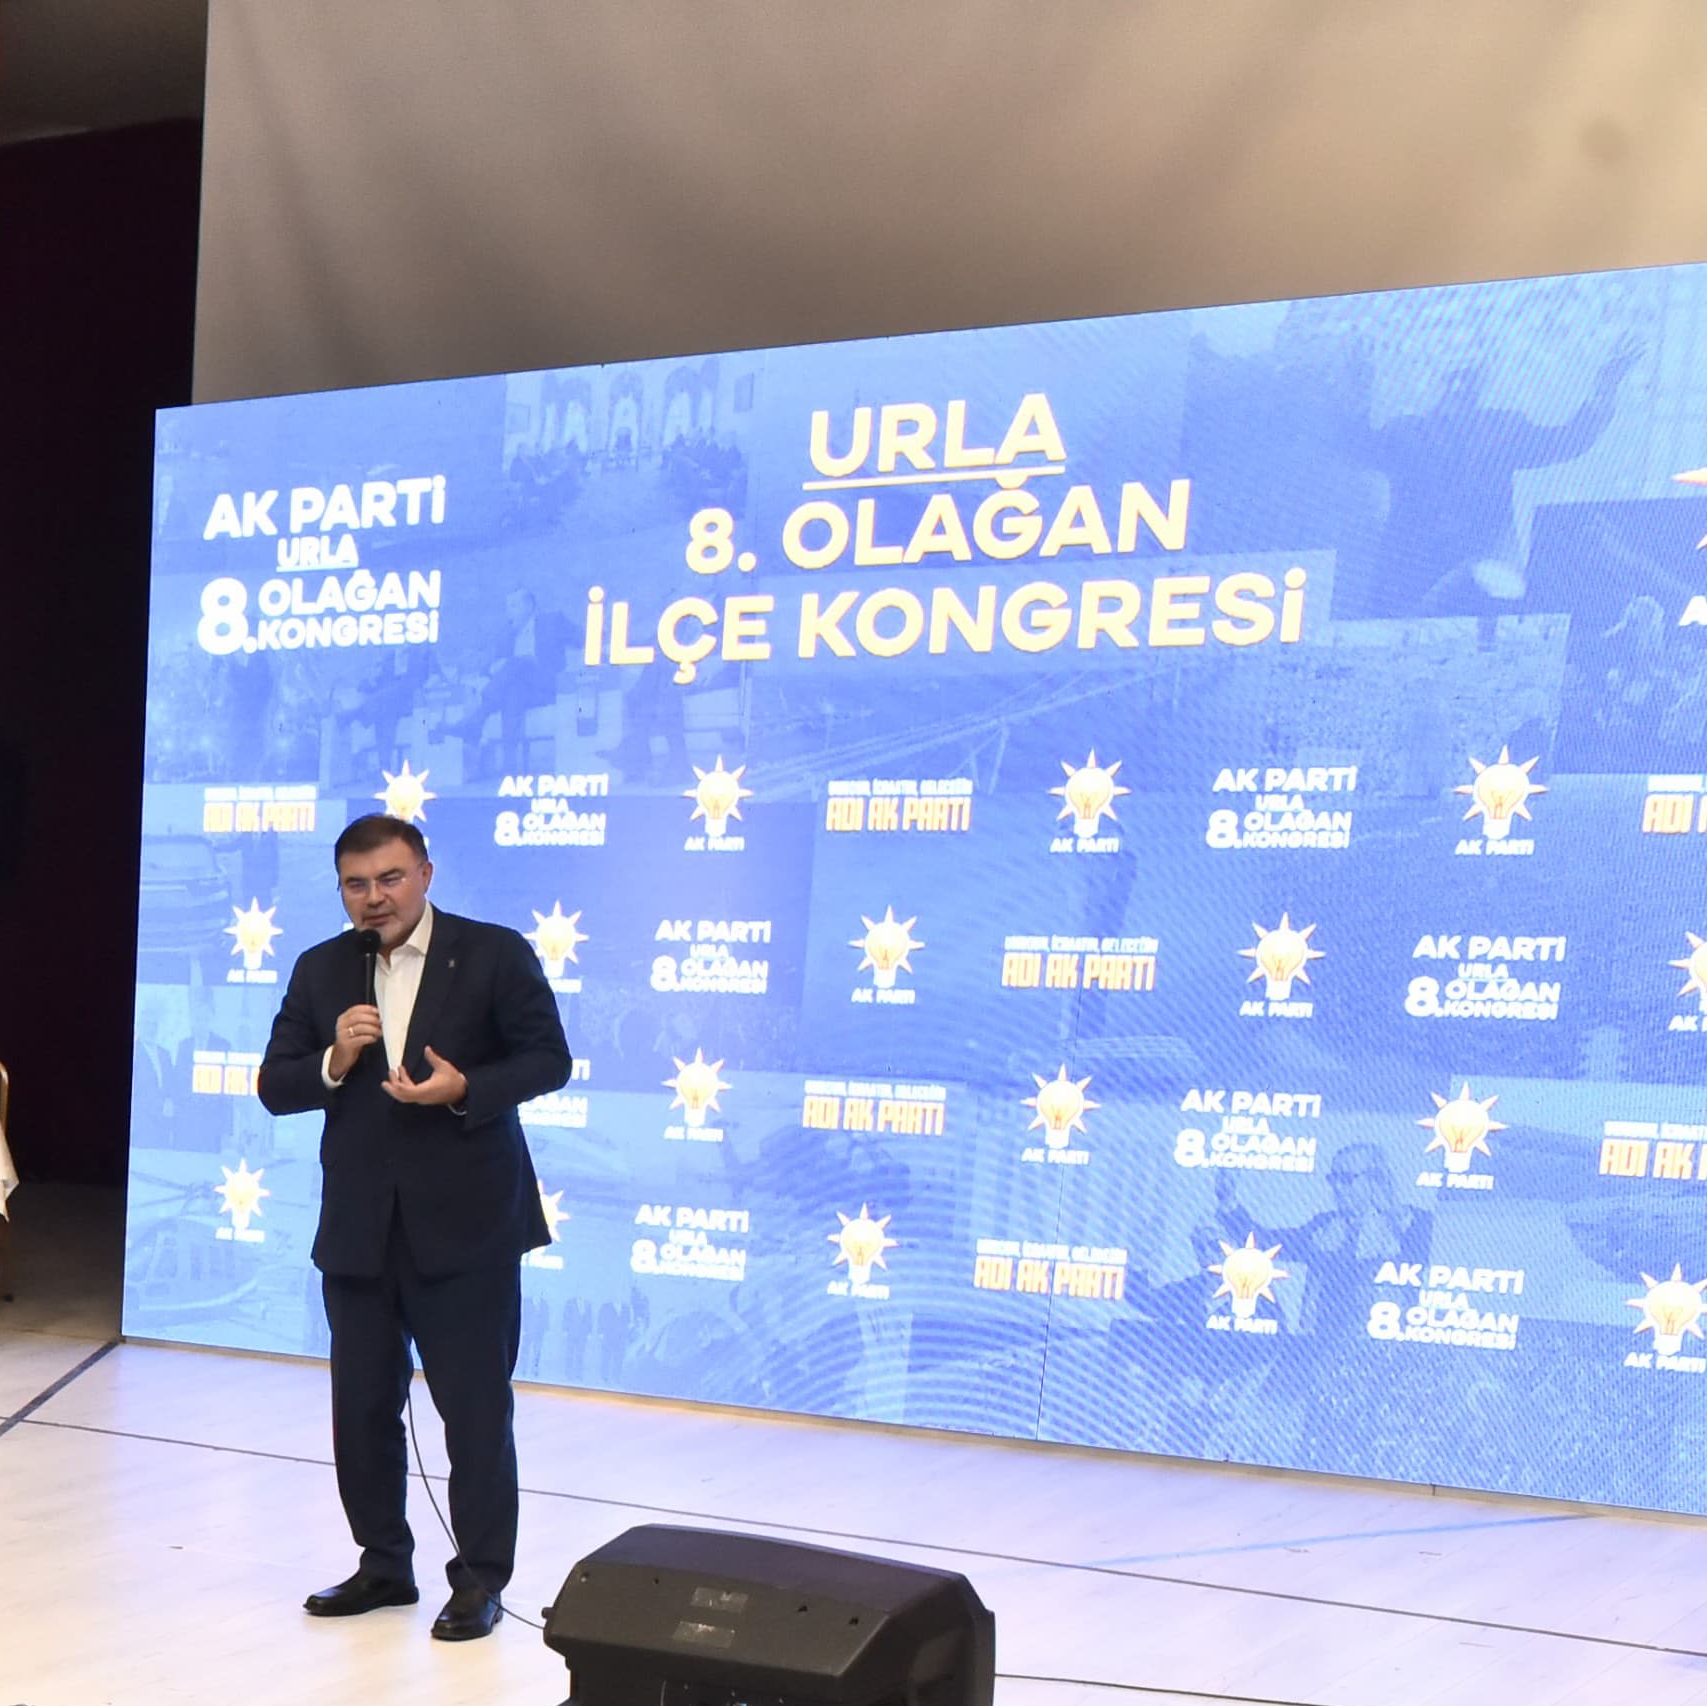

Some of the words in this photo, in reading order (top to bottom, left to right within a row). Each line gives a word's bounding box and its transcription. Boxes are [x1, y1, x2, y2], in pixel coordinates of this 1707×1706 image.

[809, 393, 1067, 477] URLA
[203, 490, 279, 540] AK
[289, 474, 446, 533] PARTİ
[685, 508, 757, 575] 8.
[782, 476, 1191, 570] OLAĞAN
[276, 533, 359, 570] URLA
[197, 577, 258, 655] 8.
[258, 569, 441, 616] OLAĞAN
[257, 609, 439, 651] KONGRESİ
[584, 585, 775, 685] İLÇE
[798, 566, 1307, 659] KONGRESİ
[498, 775, 534, 797] AK
[1212, 768, 1259, 792] AK
[1050, 838, 1073, 853] AK
[1455, 839, 1482, 855] AK
[655, 920, 692, 941] AK
[1412, 935, 1462, 959] AK
[1239, 1001, 1265, 1017] AK
[1668, 1015, 1697, 1031] AK
[1181, 1089, 1226, 1113] AK
[635, 1204, 672, 1227] AK
[1374, 1261, 1422, 1287] AK
[1206, 1315, 1231, 1331] AK
[1624, 1352, 1653, 1369] AK
